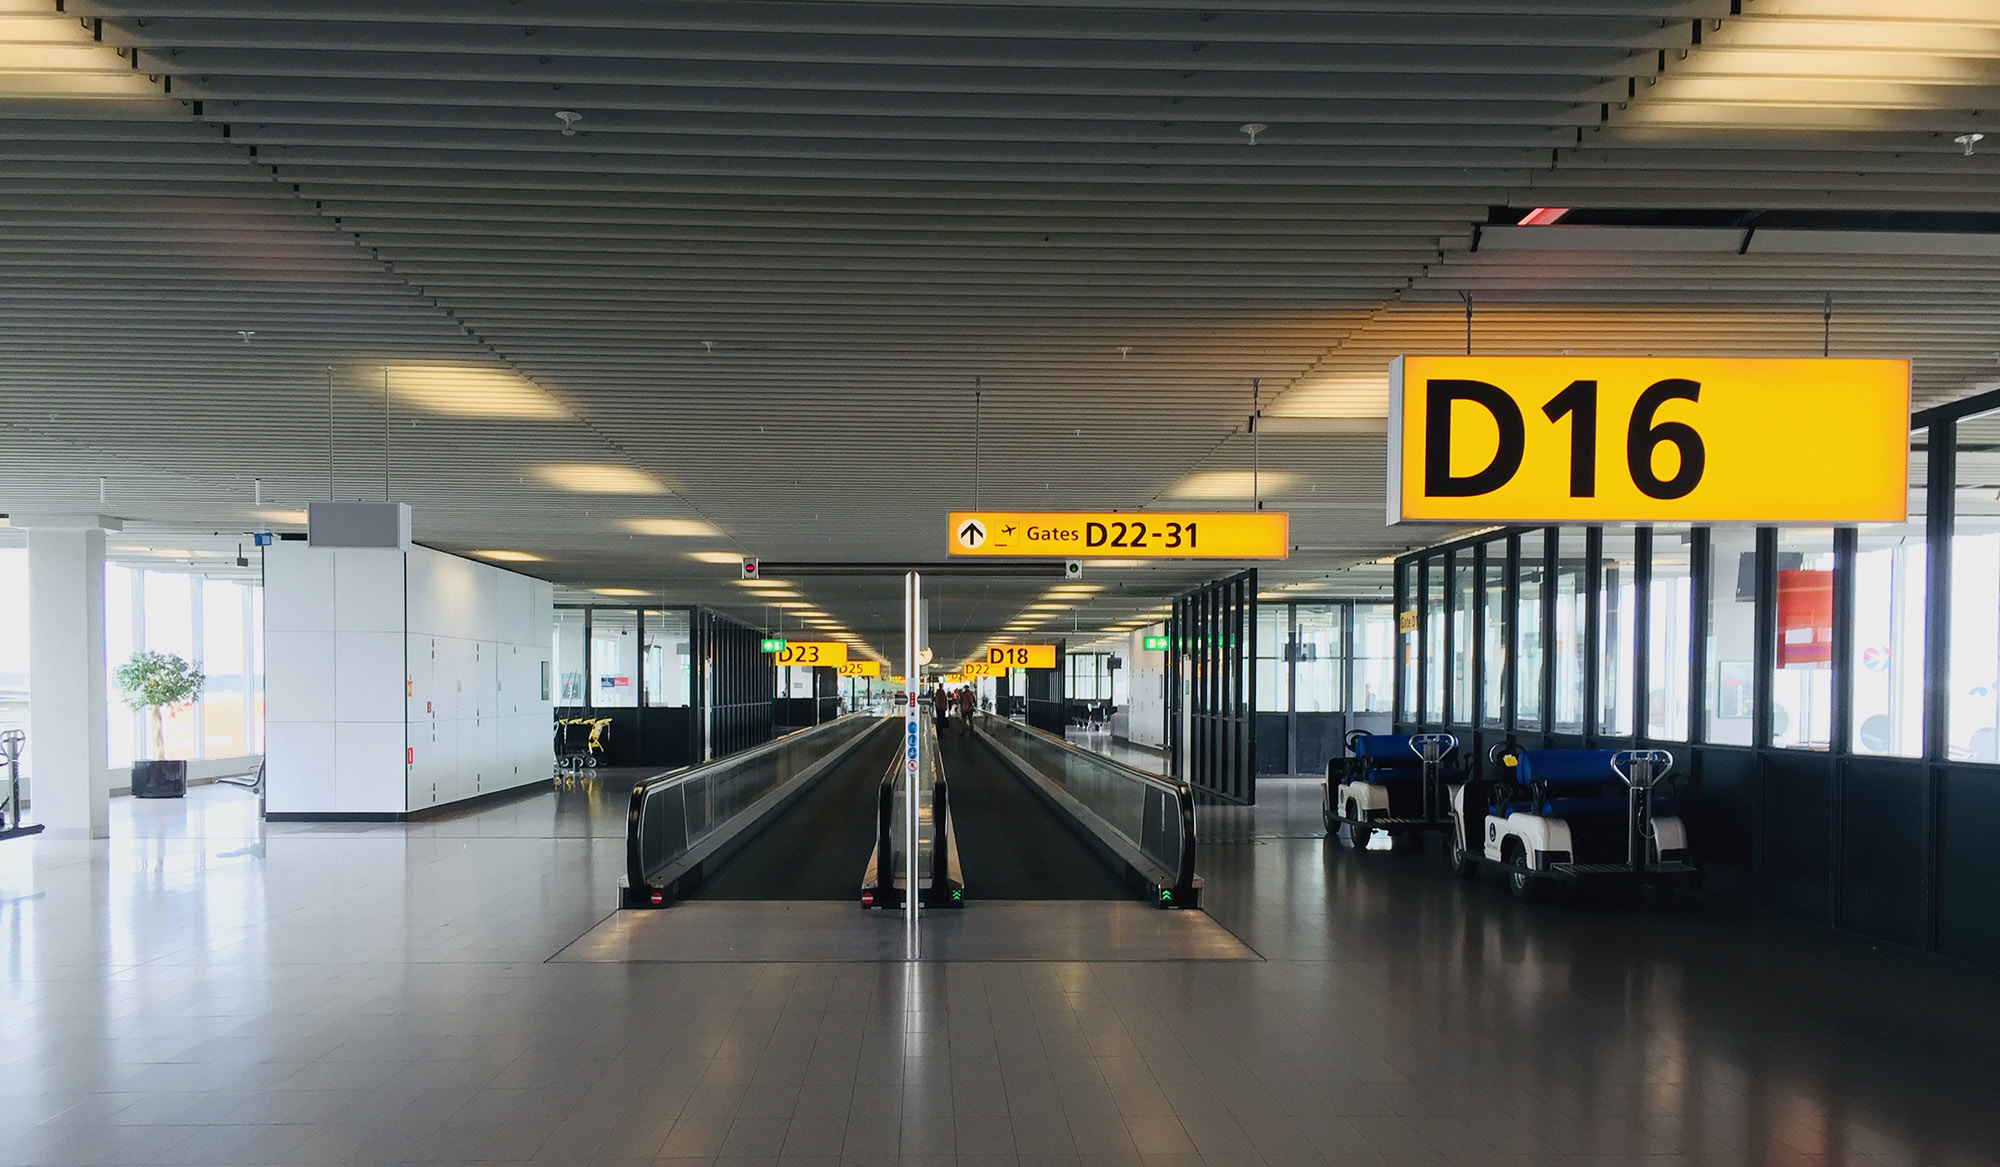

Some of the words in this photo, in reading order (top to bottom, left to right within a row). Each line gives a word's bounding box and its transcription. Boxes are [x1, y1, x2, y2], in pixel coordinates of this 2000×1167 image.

[1424, 378, 1706, 500] D16
[1027, 526, 1079, 541] Gates
[1086, 522, 1197, 548] D22-31
[778, 645, 819, 663] D23
[990, 647, 1028, 665] D18
[839, 663, 864, 674] D25
[965, 663, 989, 675] D22
